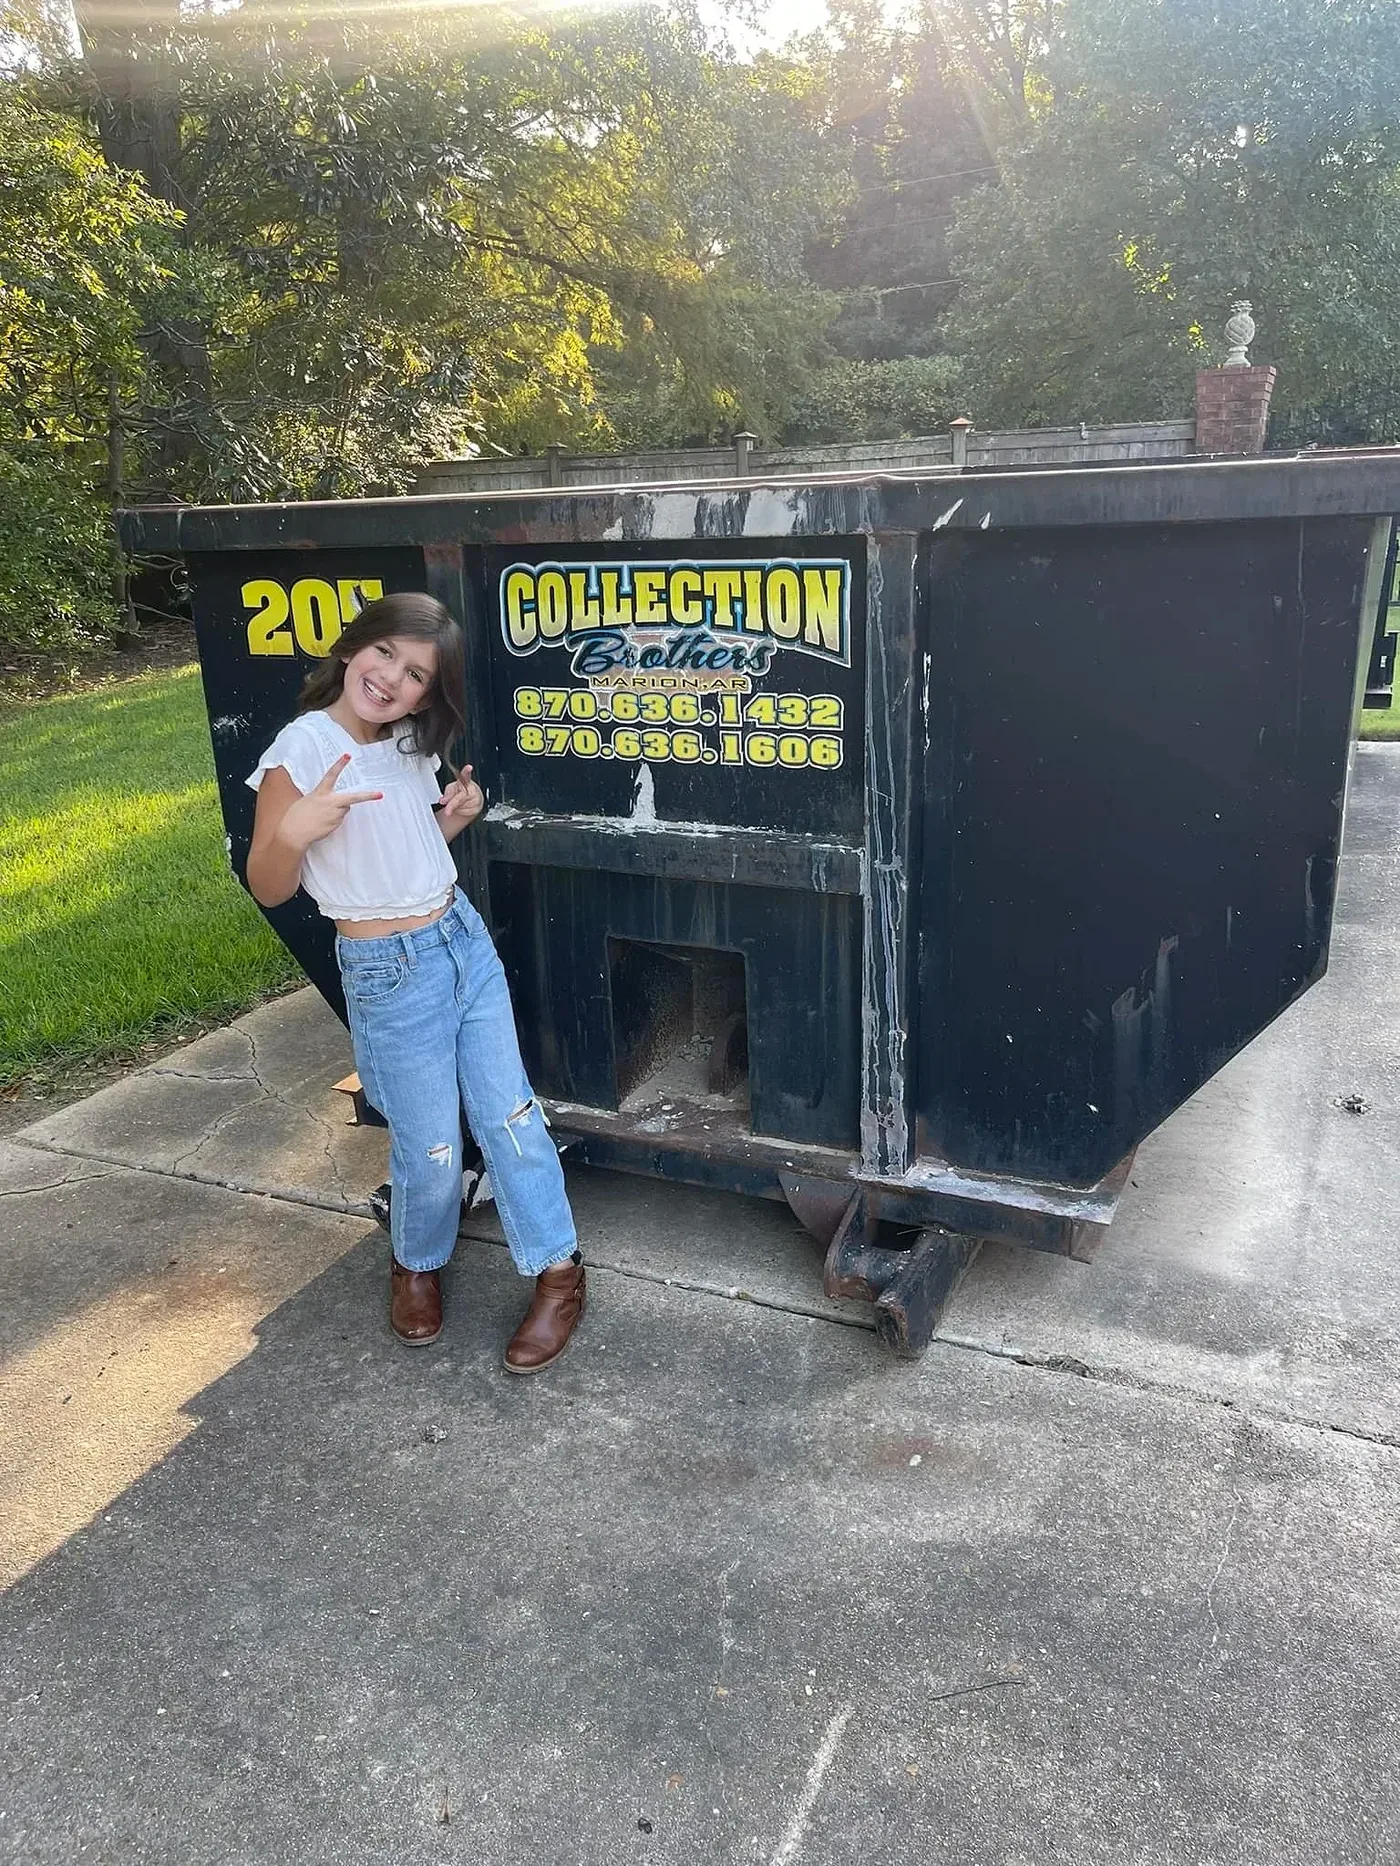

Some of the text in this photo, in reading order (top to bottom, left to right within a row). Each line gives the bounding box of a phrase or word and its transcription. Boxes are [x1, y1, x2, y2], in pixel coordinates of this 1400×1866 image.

[504, 563, 847, 658] COLLECTION
[569, 632, 775, 674] Brothers
[515, 688, 841, 729] 870.636.1432
[518, 724, 841, 768] 870.636.1606
